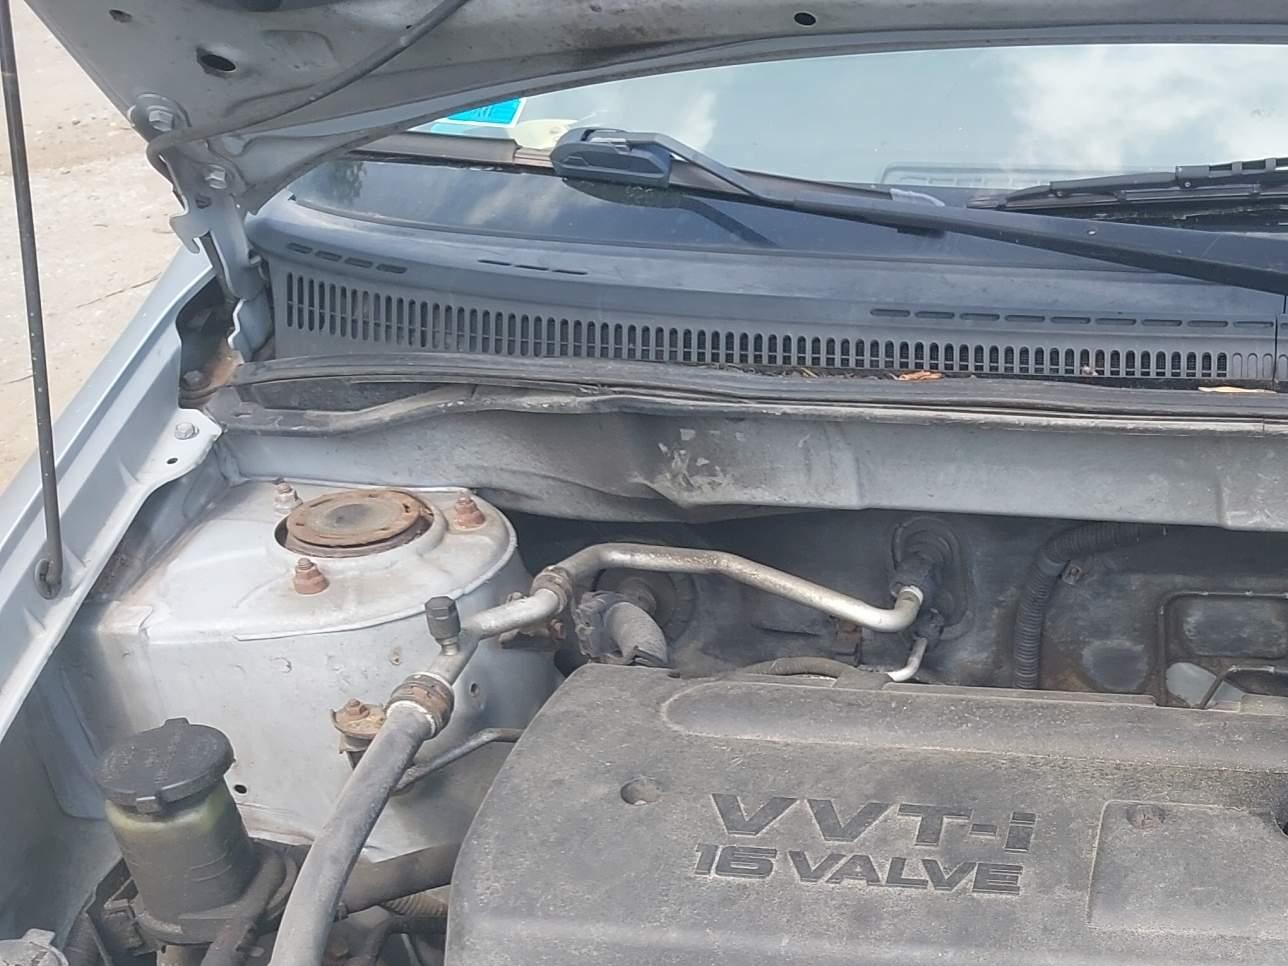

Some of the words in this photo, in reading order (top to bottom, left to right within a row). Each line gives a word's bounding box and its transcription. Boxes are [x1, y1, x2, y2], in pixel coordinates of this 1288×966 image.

[710, 793, 1038, 853] VVT-i
[693, 843, 778, 879] 16
[789, 850, 1023, 896] VALVE
